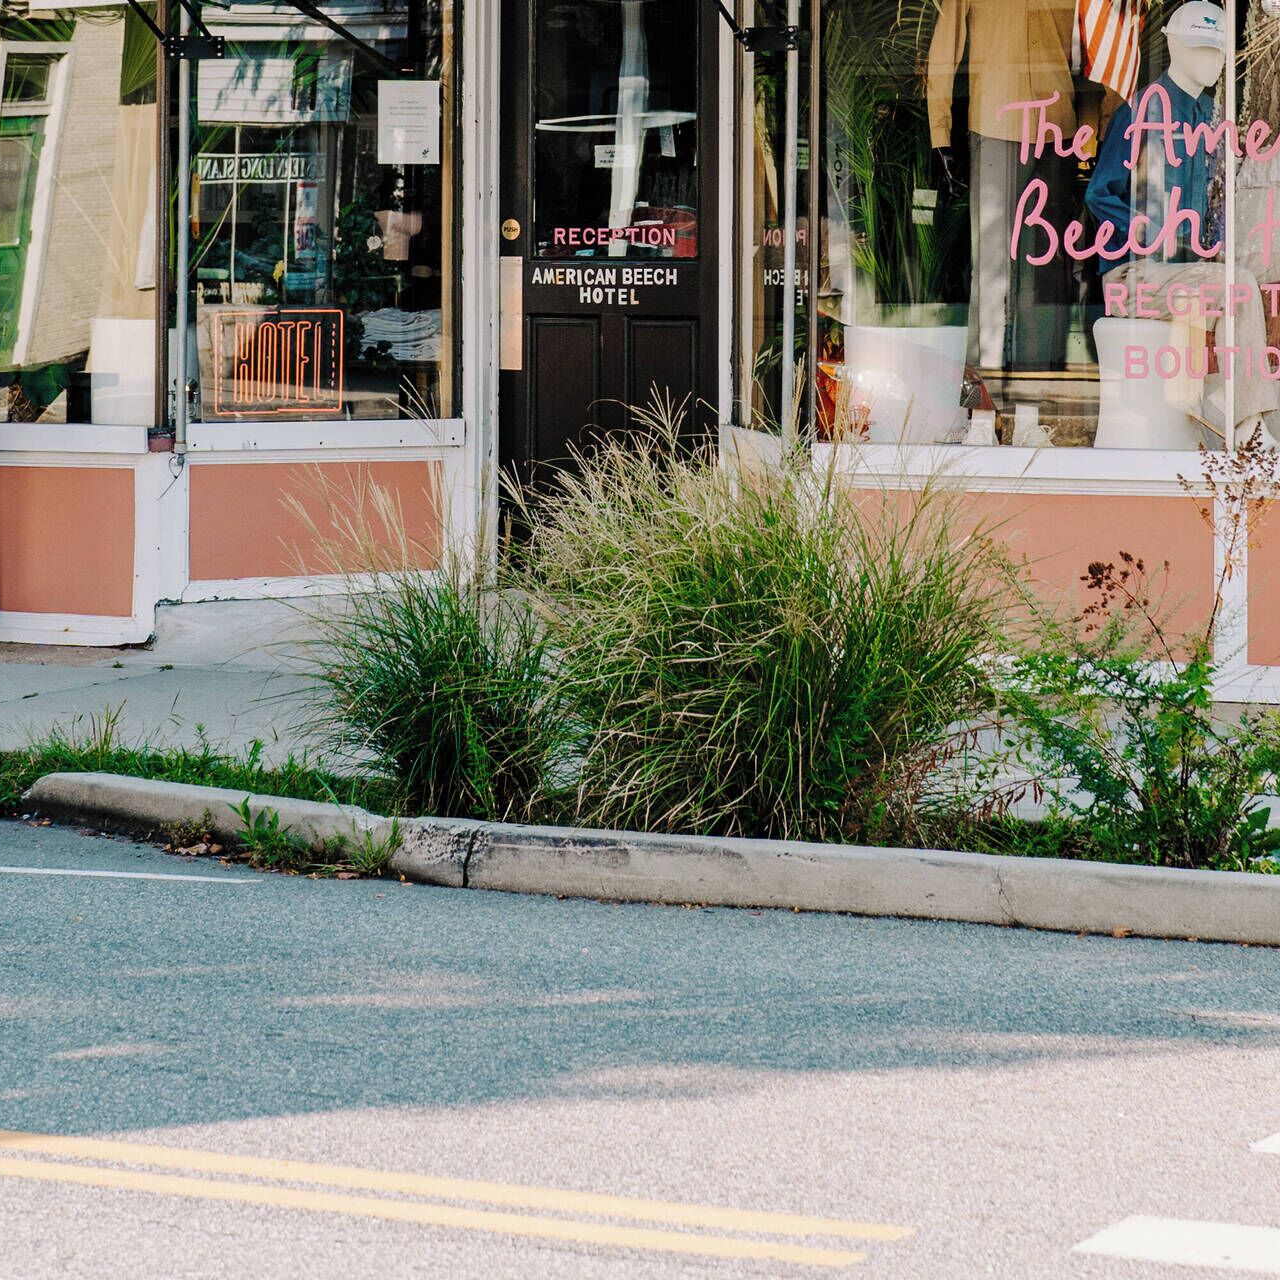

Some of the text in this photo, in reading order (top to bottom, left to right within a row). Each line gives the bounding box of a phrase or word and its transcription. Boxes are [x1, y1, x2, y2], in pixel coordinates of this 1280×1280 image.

[997, 91, 1095, 165] The
[553, 227, 676, 246] RECEPTION
[1011, 178, 1221, 267] Beech
[531, 267, 678, 286] AMERICAN BEECH
[579, 287, 641, 305] HOTEL
[233, 320, 326, 403] HOTEL
